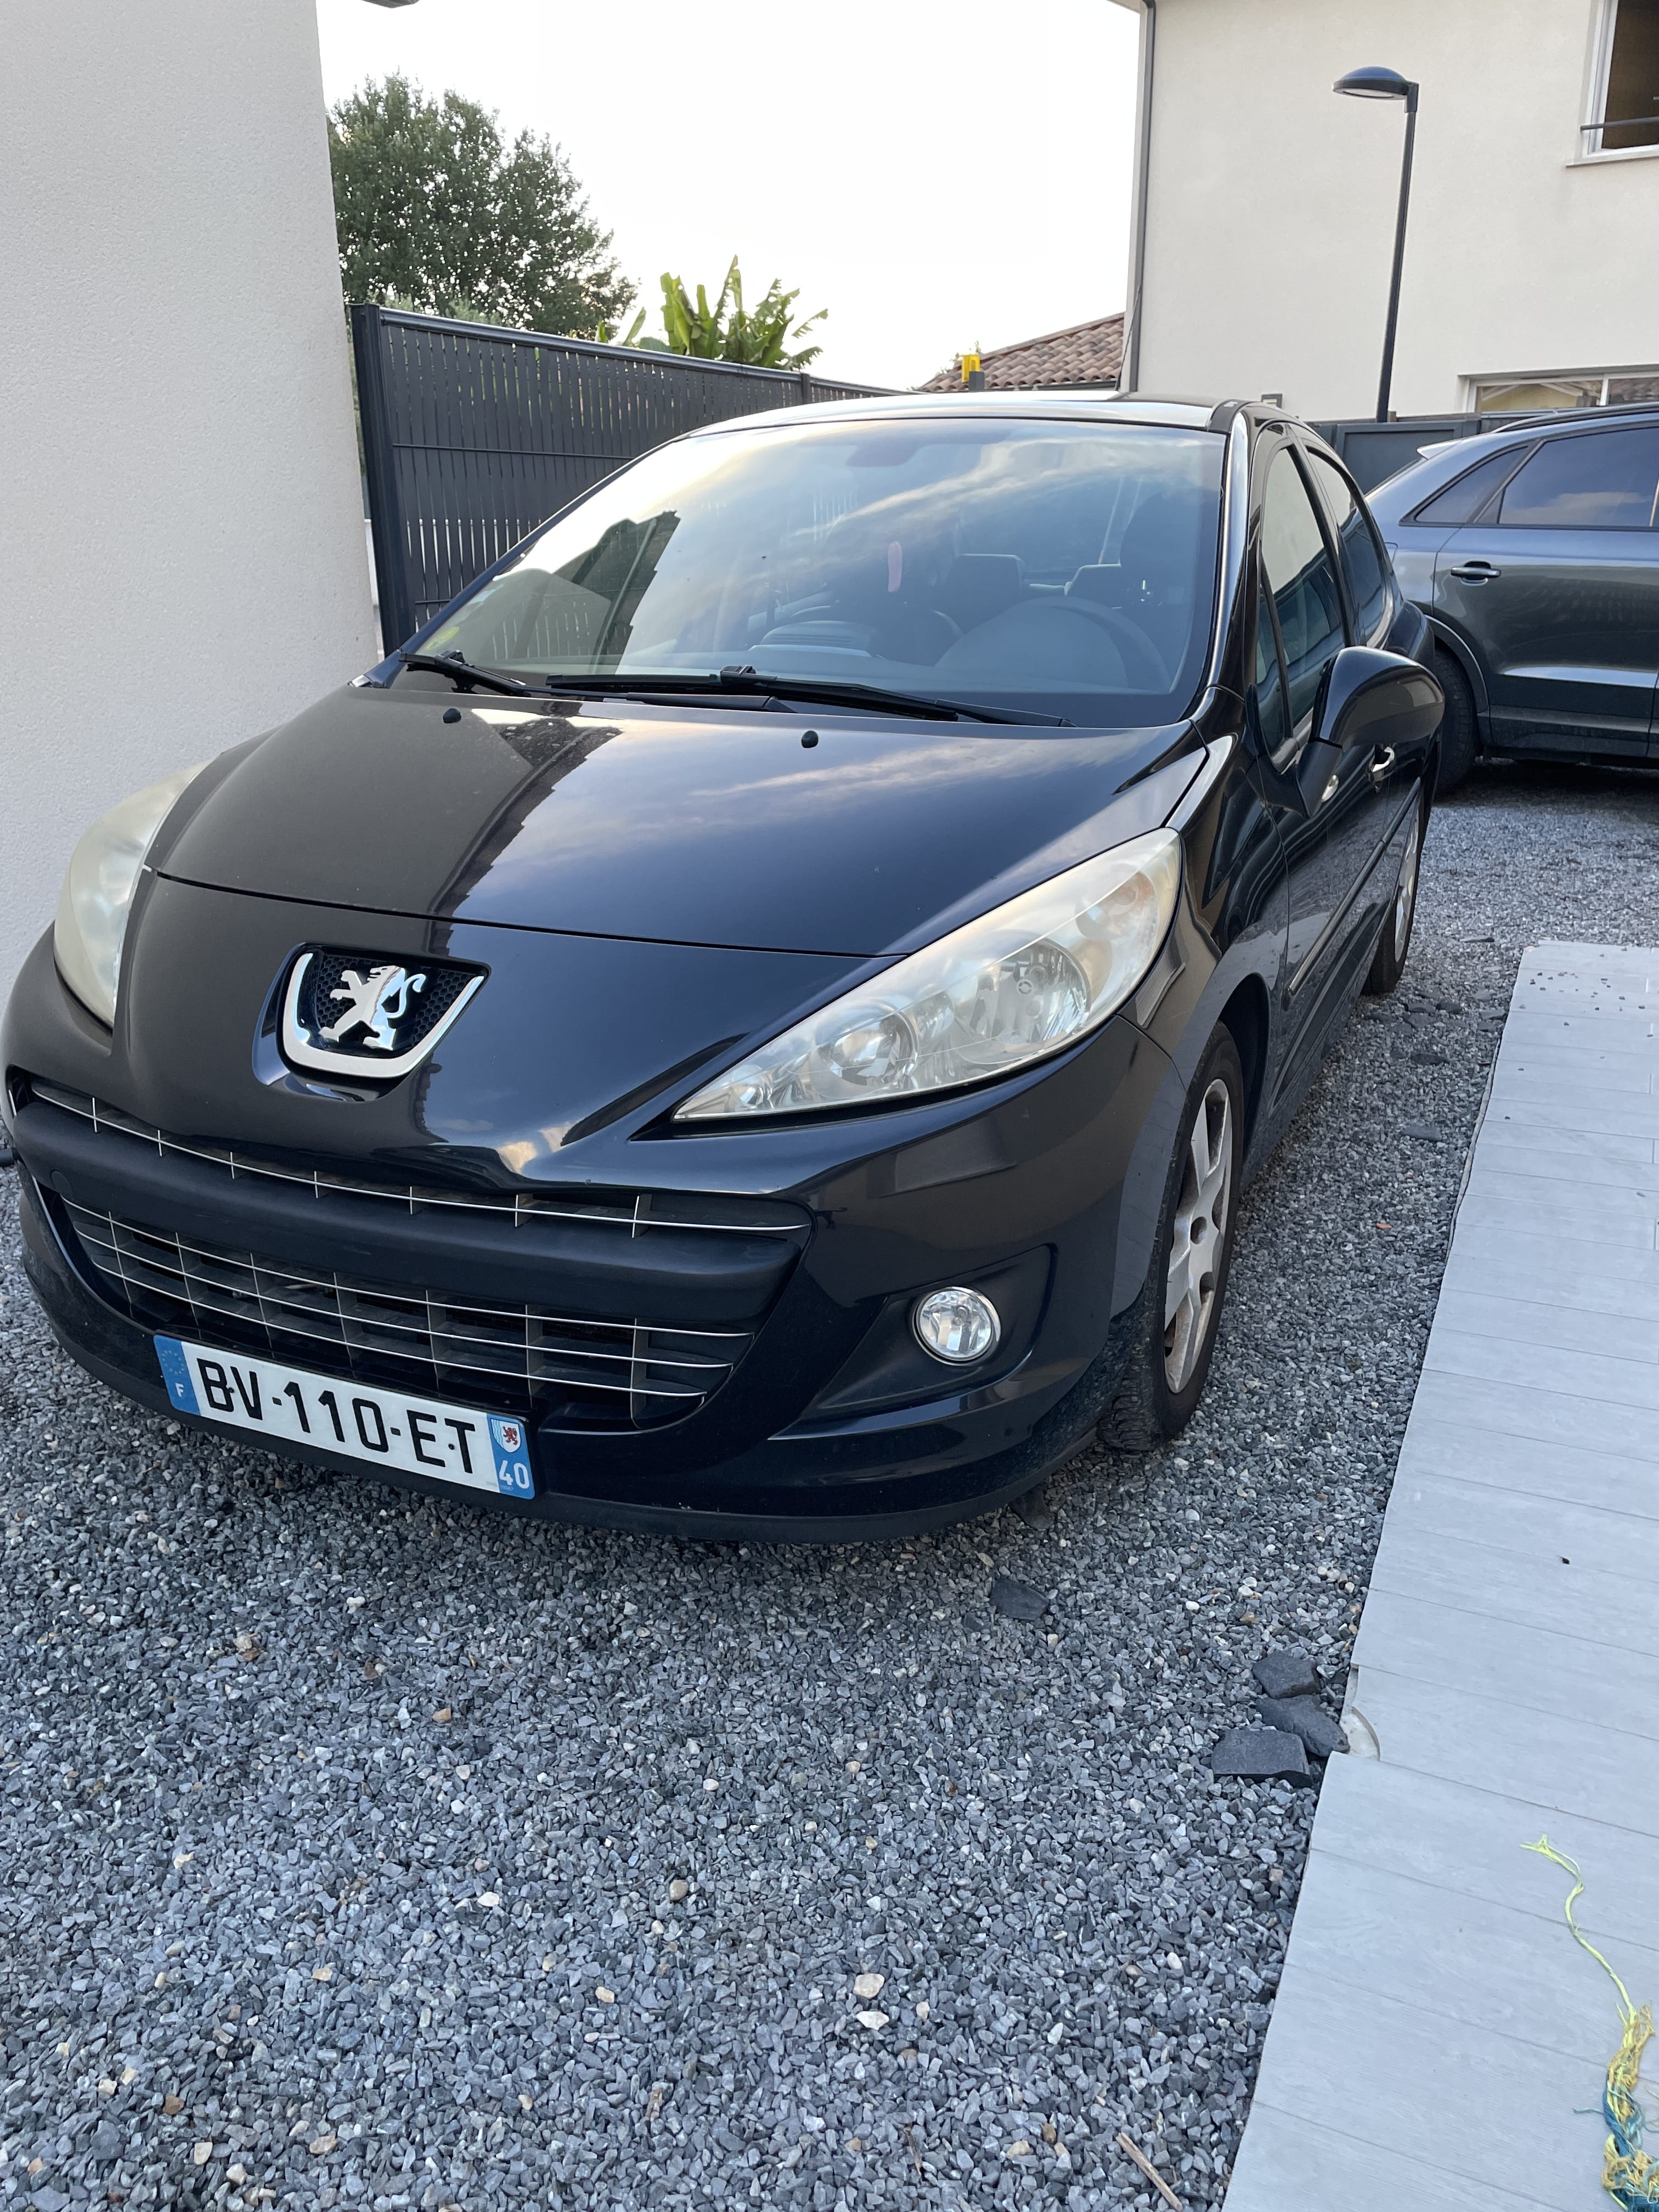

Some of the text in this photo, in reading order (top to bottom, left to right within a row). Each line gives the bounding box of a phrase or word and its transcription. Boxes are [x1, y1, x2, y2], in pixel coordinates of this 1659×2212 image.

[175, 1383, 184, 1397] F
[197, 1358, 476, 1474] BV-110-ET
[500, 1460, 529, 1489] 40
